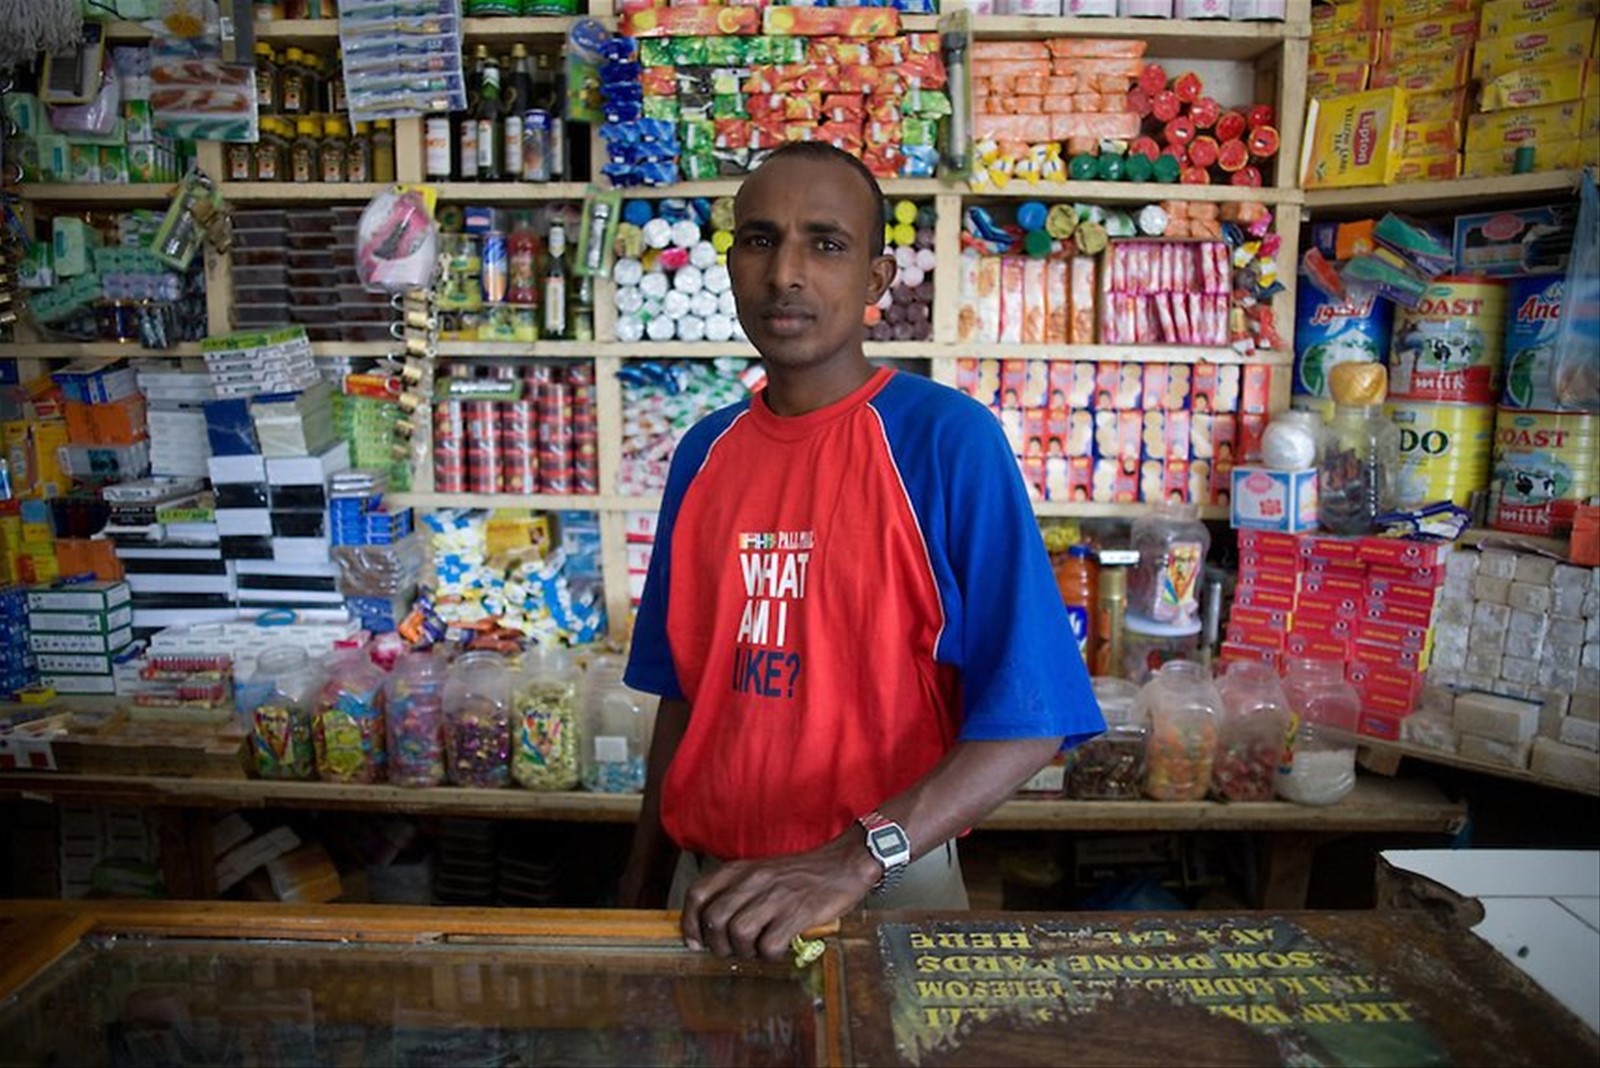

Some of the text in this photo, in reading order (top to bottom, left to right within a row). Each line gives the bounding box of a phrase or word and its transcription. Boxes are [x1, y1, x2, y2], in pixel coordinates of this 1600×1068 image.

[1356, 111, 1376, 164] Lipton
[1415, 373, 1466, 390] milk
[1500, 506, 1550, 525] milk
[740, 552, 809, 598] WHAT
[737, 599, 787, 647] AM I
[732, 647, 801, 698] LIKE?
[1069, 952, 1217, 973] PHONE
